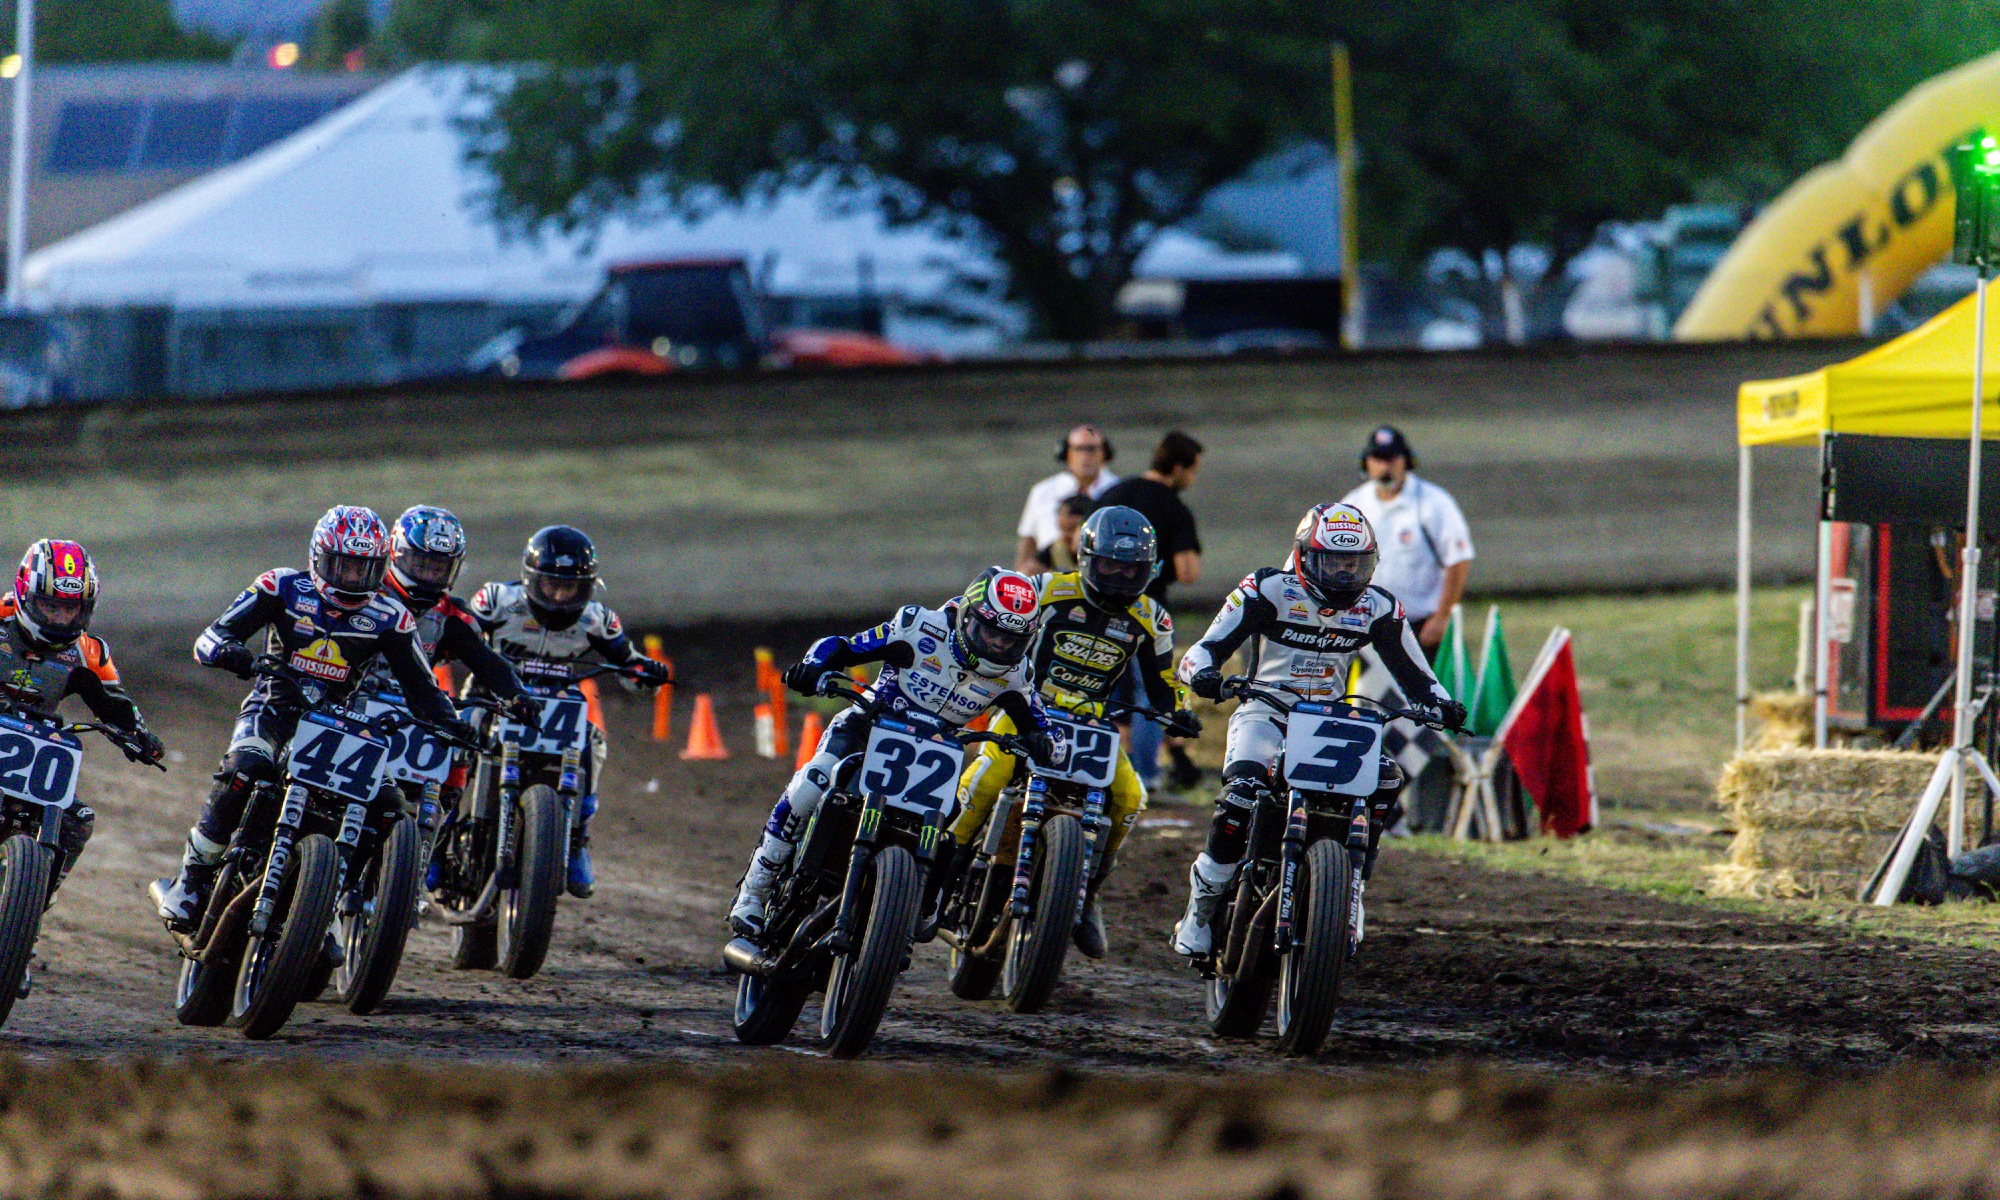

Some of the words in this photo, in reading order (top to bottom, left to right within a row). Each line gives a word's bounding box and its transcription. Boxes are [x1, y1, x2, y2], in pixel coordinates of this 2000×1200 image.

[1333, 535, 1356, 544] Arai
[57, 578, 82, 590] Arai
[1003, 583, 1033, 598] RESET
[295, 602, 318, 615] MOLY
[1000, 614, 1024, 627] Arai
[1281, 629, 1318, 645] PARTS
[1059, 641, 1119, 666] SHADES
[1049, 665, 1104, 690] Corbin
[909, 671, 987, 711] ESTENSON
[1288, 720, 1377, 784] 3
[0, 733, 75, 803] 20
[293, 729, 386, 801] 44
[864, 738, 957, 812] 32
[266, 836, 293, 891] LIQUI
[1284, 861, 1297, 887] PARTS
[1281, 897, 1293, 919] PLUS
